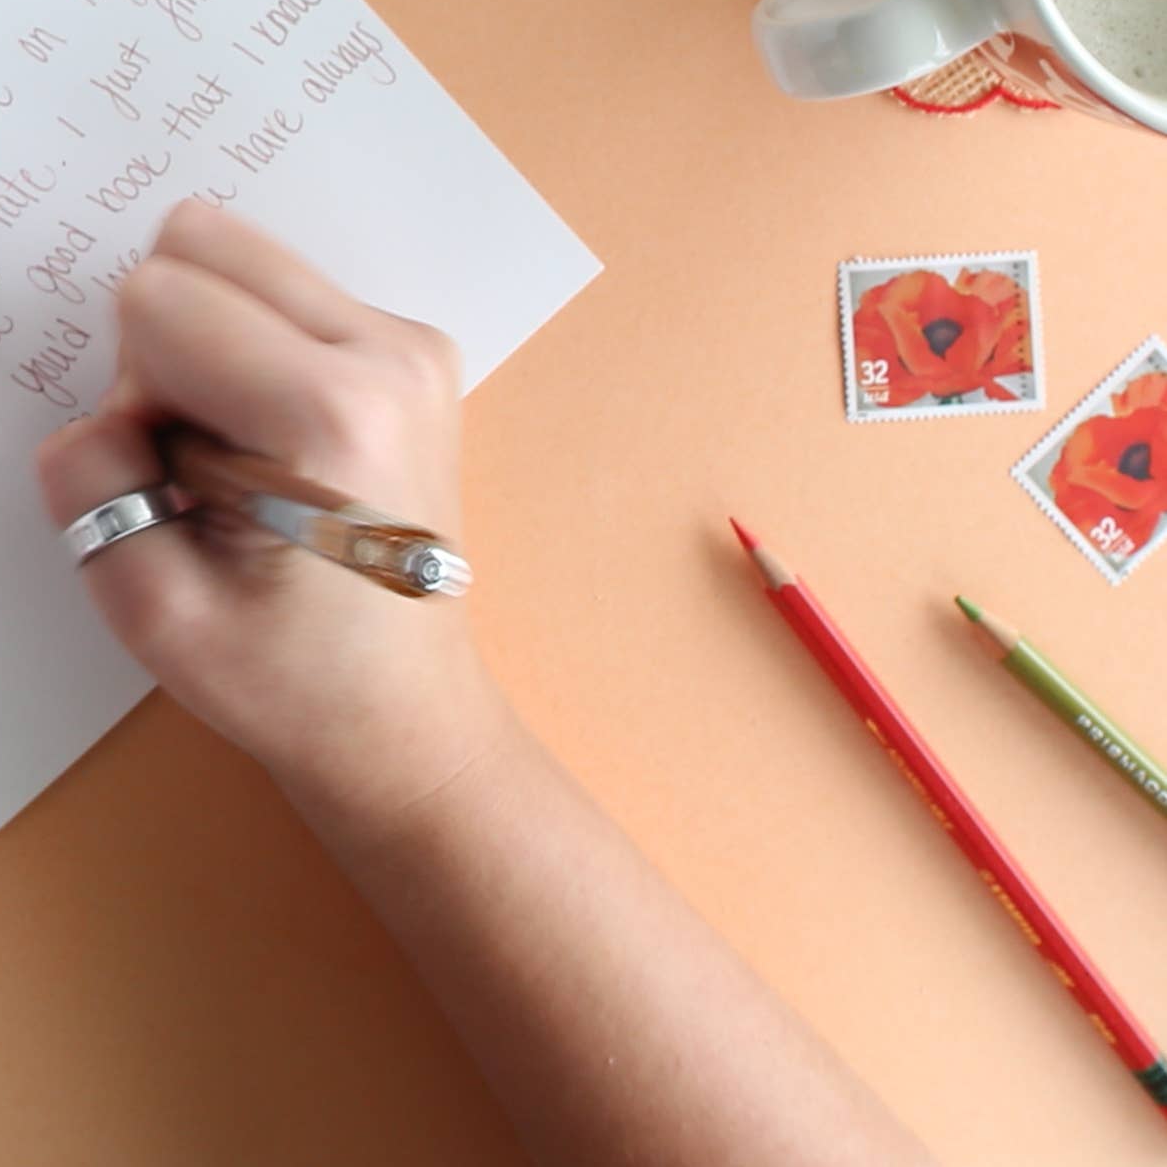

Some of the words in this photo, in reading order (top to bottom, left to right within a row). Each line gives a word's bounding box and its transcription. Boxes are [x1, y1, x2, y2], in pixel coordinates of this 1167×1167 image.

[18, 27, 67, 64] on
[90, 37, 151, 122] just
[27, 220, 97, 304] good
[85, 150, 172, 213] book
[162, 73, 233, 141] that
[232, 42, 265, 66] I
[10, 317, 91, 408] you'd
[302, 21, 396, 103] always
[861, 359, 889, 385] 32
[1090, 516, 1123, 550] 32
